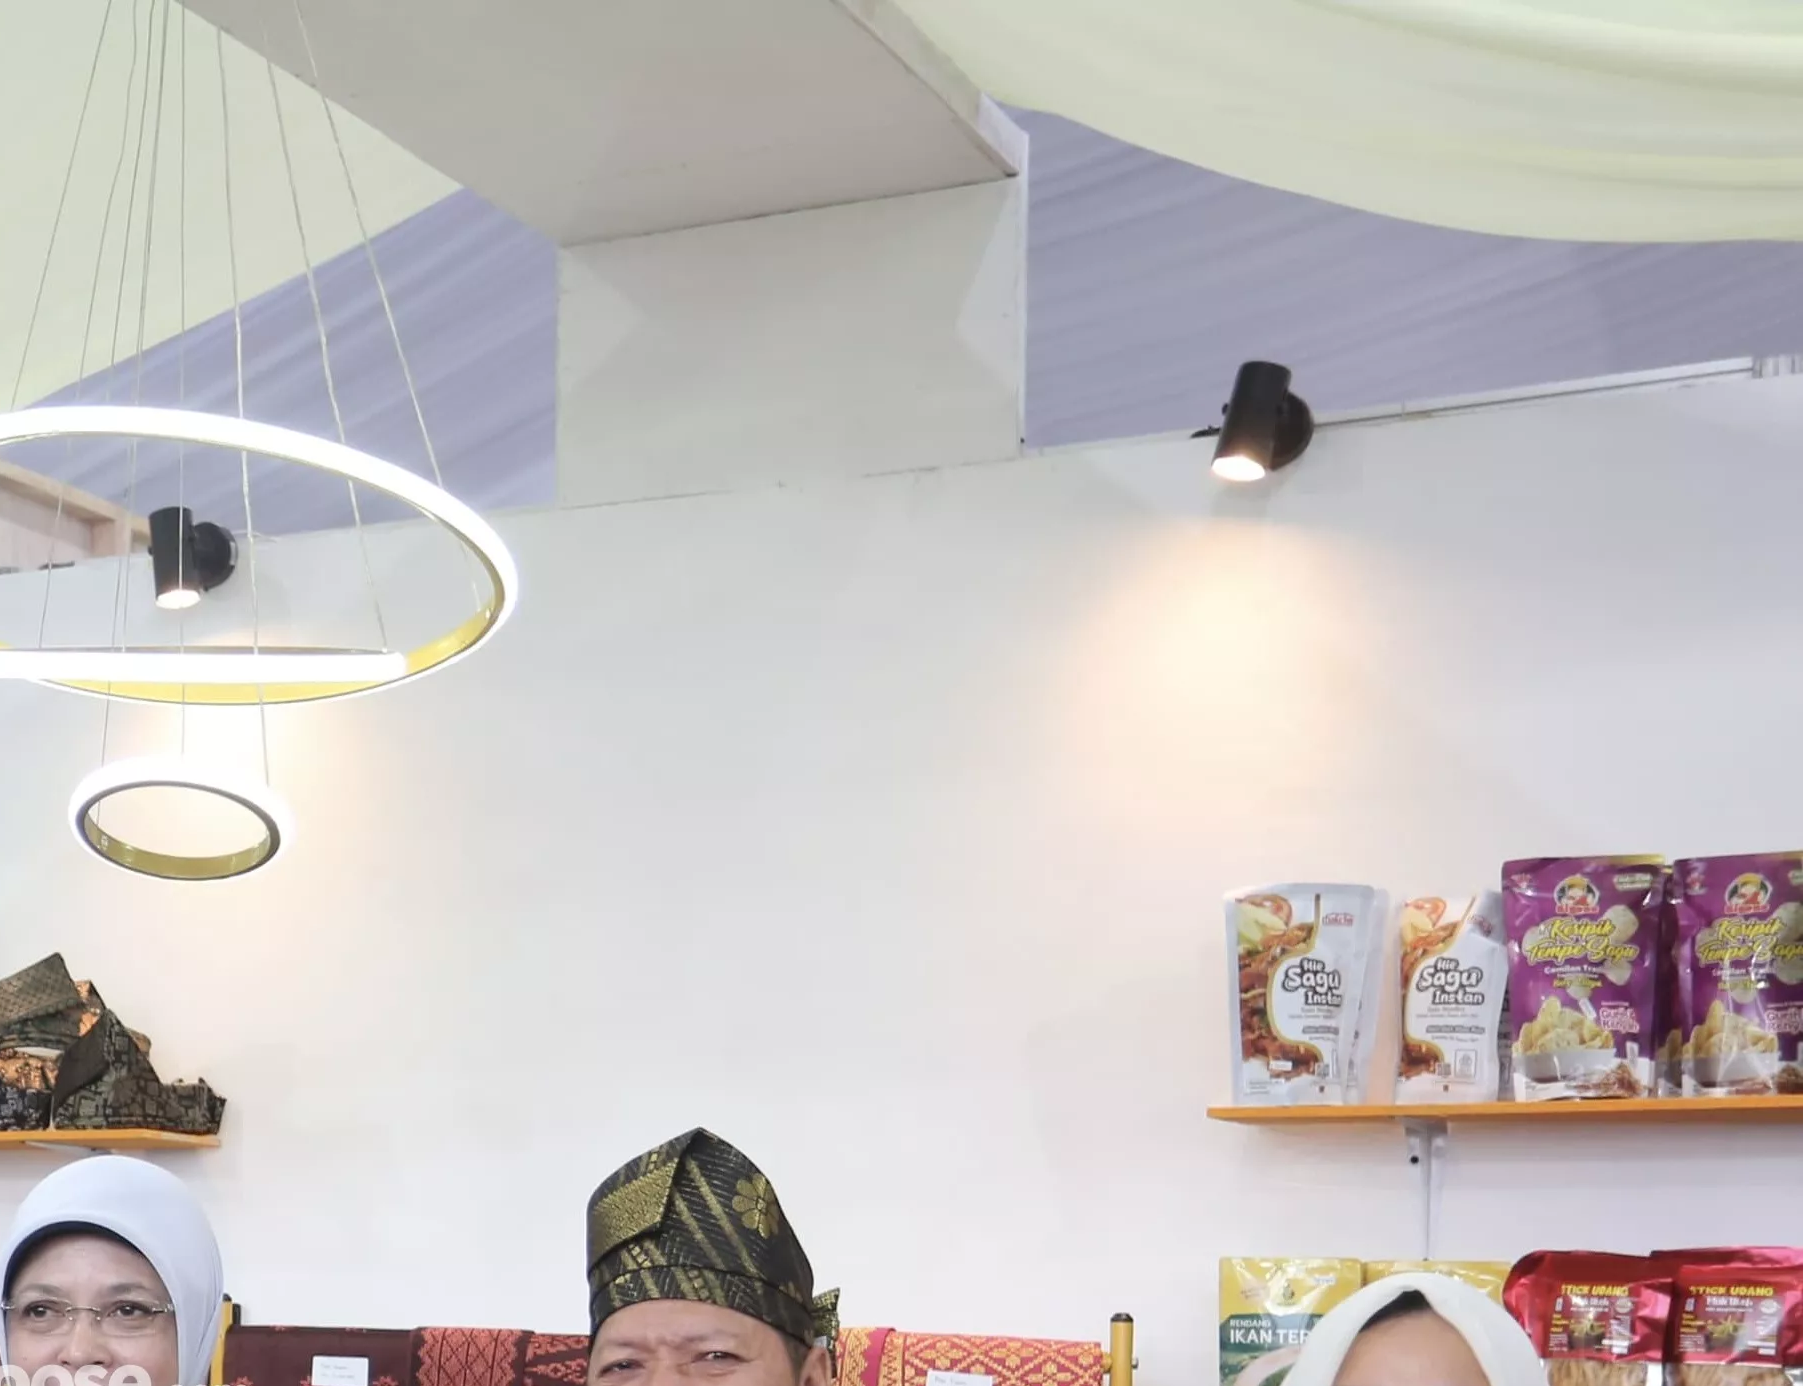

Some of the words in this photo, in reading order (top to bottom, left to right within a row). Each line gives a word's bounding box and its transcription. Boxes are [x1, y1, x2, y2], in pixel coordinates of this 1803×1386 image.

[1283, 965, 1341, 993] Sagu
[1417, 966, 1483, 993] Sagu
[1432, 990, 1485, 1005] Instan
[1229, 1319, 1272, 1328] RENDANG
[1229, 1329, 1272, 1344] IKAN
